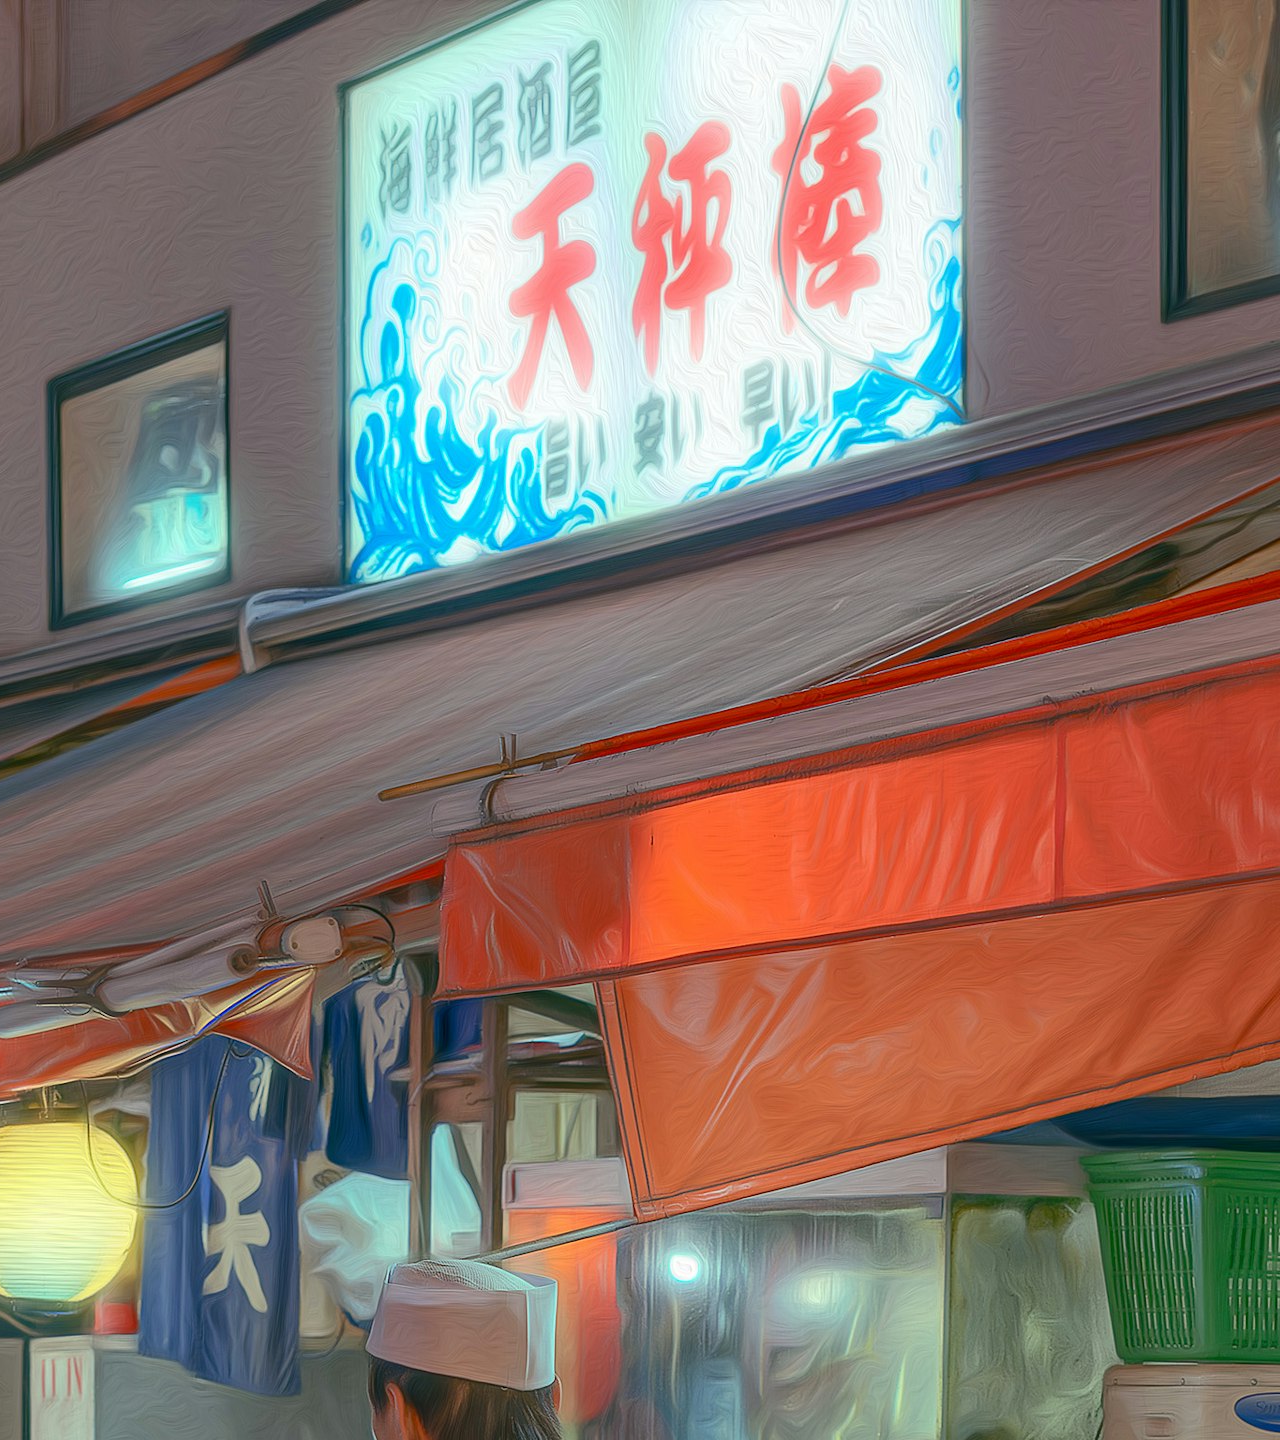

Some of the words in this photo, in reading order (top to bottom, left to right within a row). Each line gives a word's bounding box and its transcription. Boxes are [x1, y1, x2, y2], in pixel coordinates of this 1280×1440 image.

[377, 40, 603, 217] 海鮮居酒屋
[202, 1155, 270, 1314] 天
